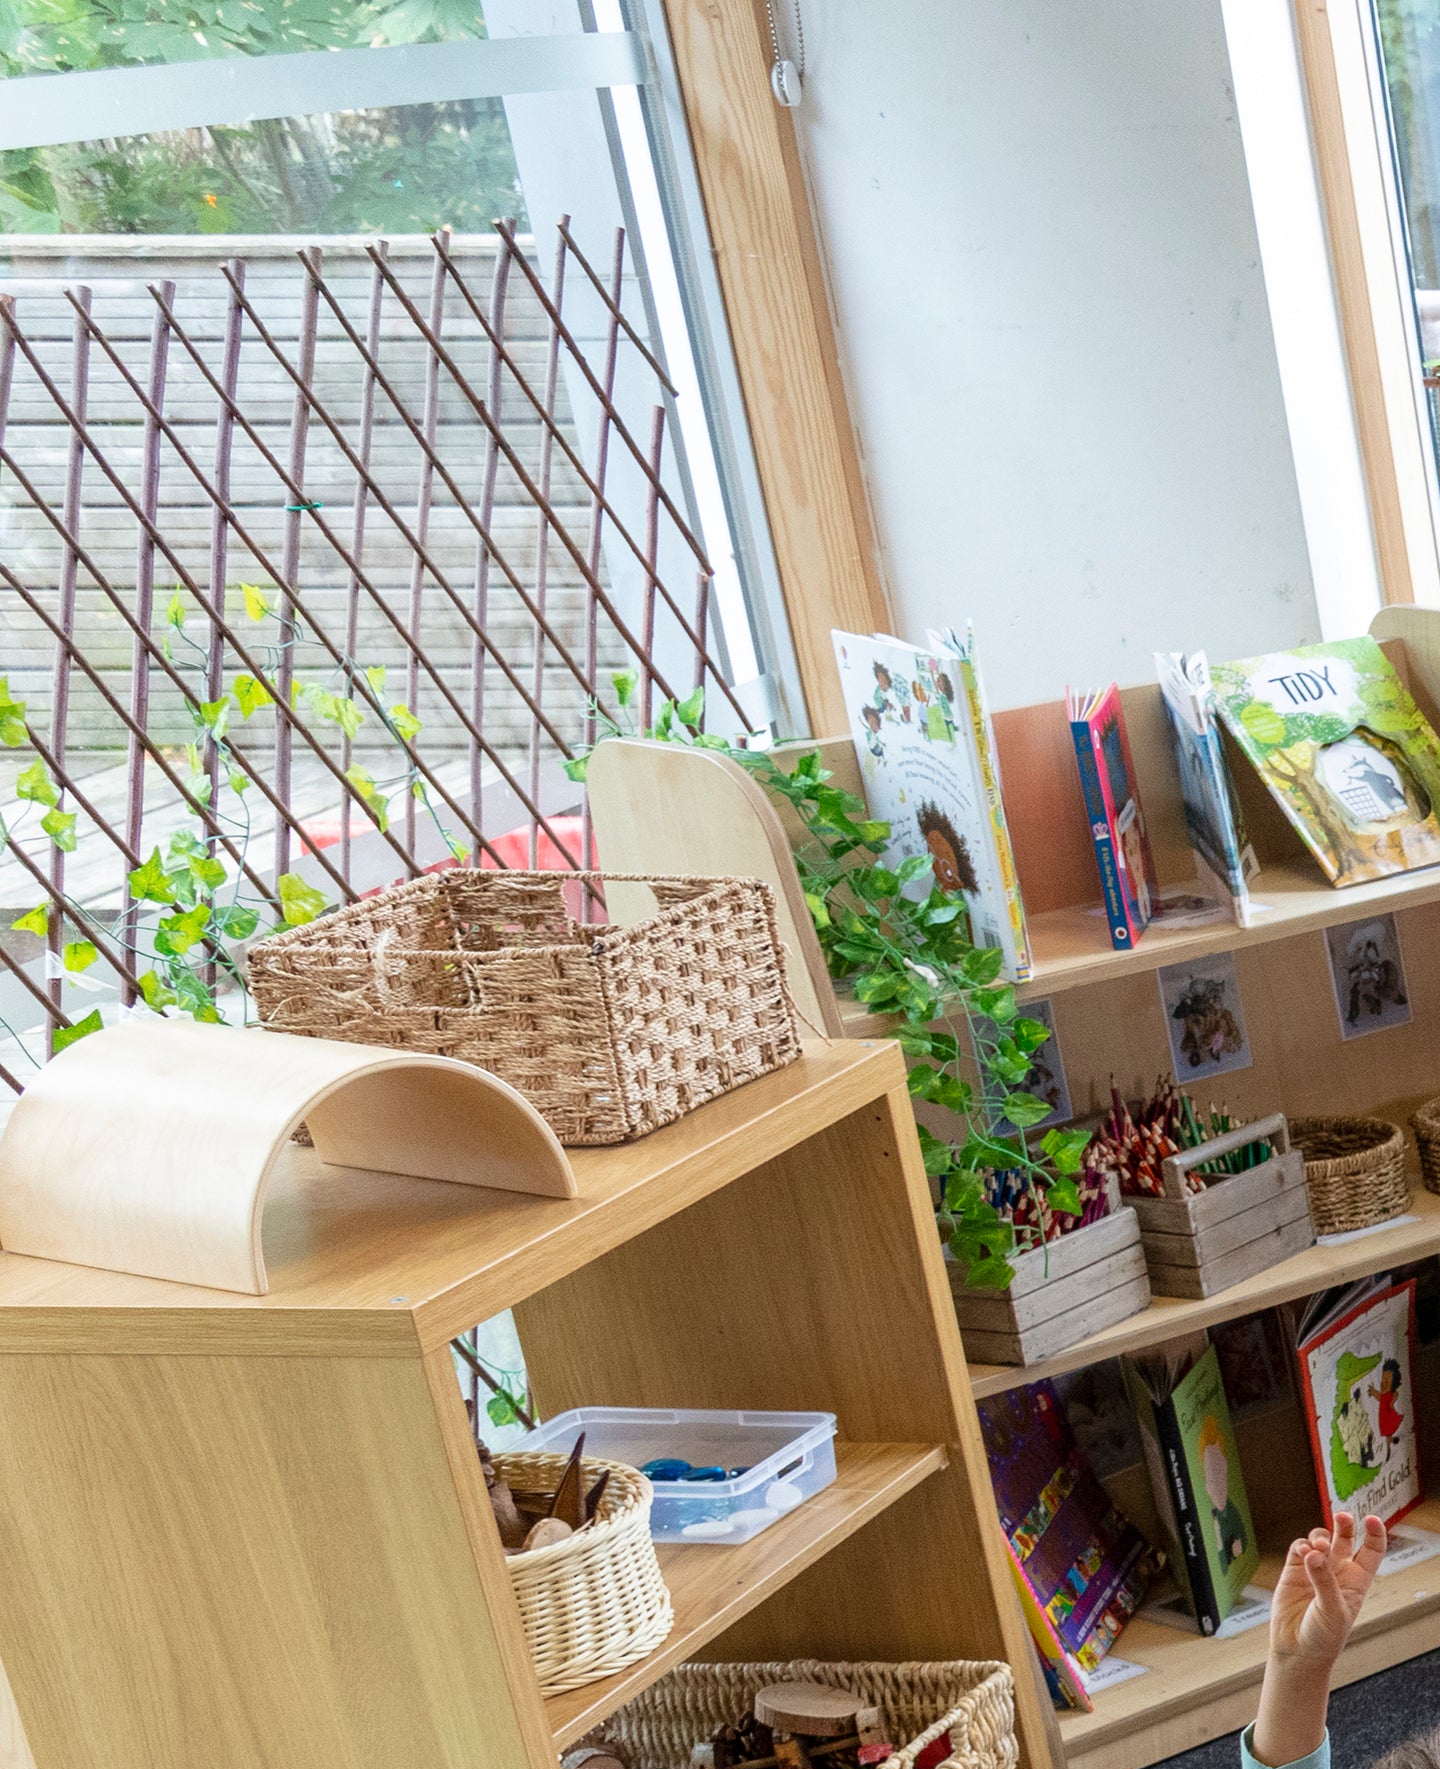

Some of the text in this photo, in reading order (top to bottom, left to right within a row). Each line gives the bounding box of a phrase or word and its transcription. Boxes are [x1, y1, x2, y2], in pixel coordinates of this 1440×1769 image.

[1267, 664, 1338, 706] TIDY
[1367, 1476, 1387, 1510] Find
[1388, 1457, 1411, 1491] Gold
